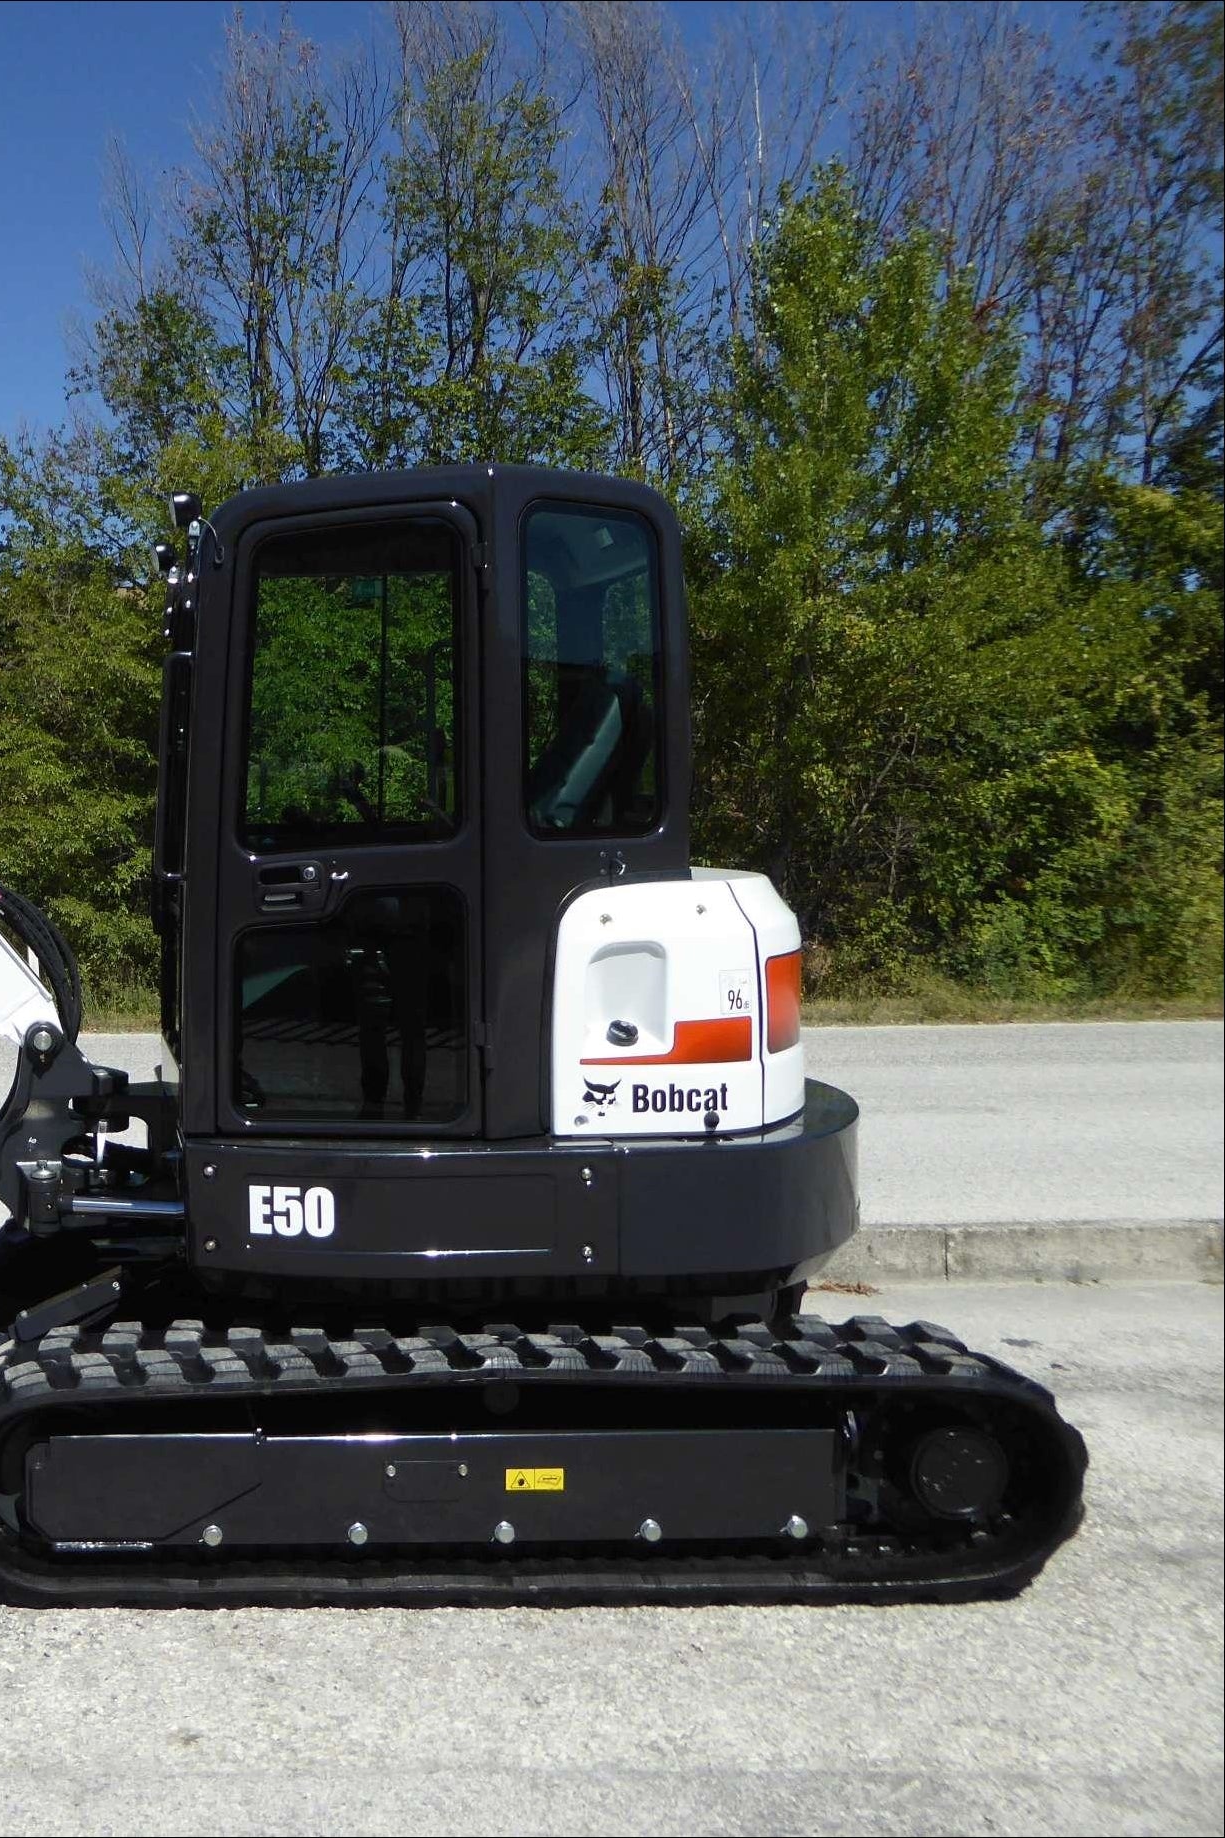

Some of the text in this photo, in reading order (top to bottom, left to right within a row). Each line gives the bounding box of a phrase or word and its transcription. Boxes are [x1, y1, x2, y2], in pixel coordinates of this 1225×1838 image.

[728, 988, 742, 1010] 96
[632, 1083, 728, 1113] Bobcat
[248, 1185, 335, 1238] E50
